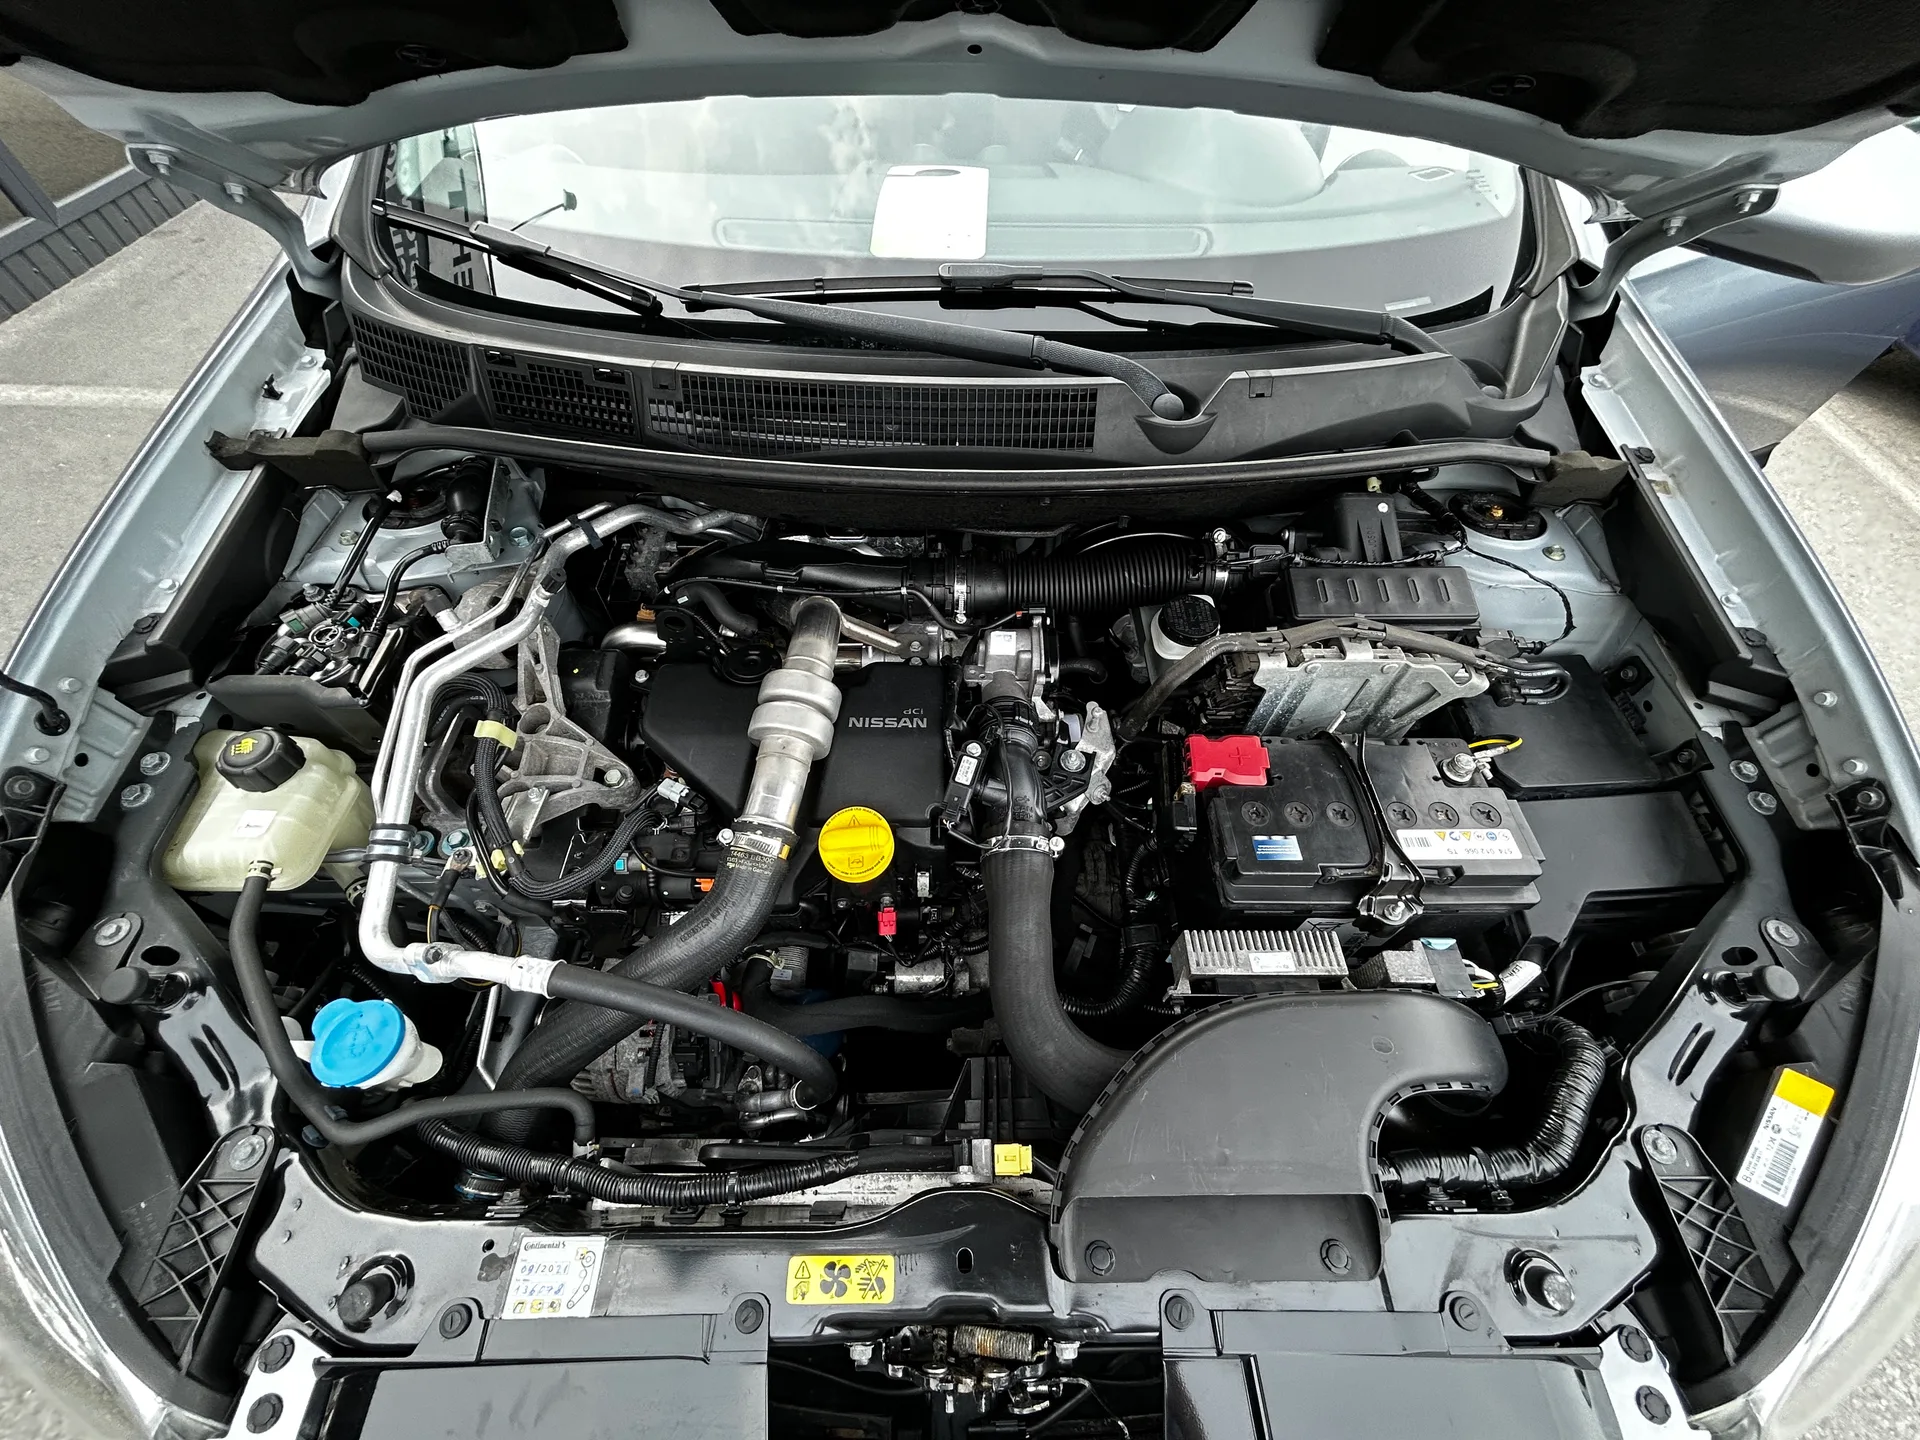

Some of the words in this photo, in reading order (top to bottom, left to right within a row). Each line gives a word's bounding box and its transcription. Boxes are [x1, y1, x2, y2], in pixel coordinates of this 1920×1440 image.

[848, 717, 927, 728] NISSAN
[1763, 1106, 1777, 1131] NISSAN
[524, 1241, 561, 1252] Continental
